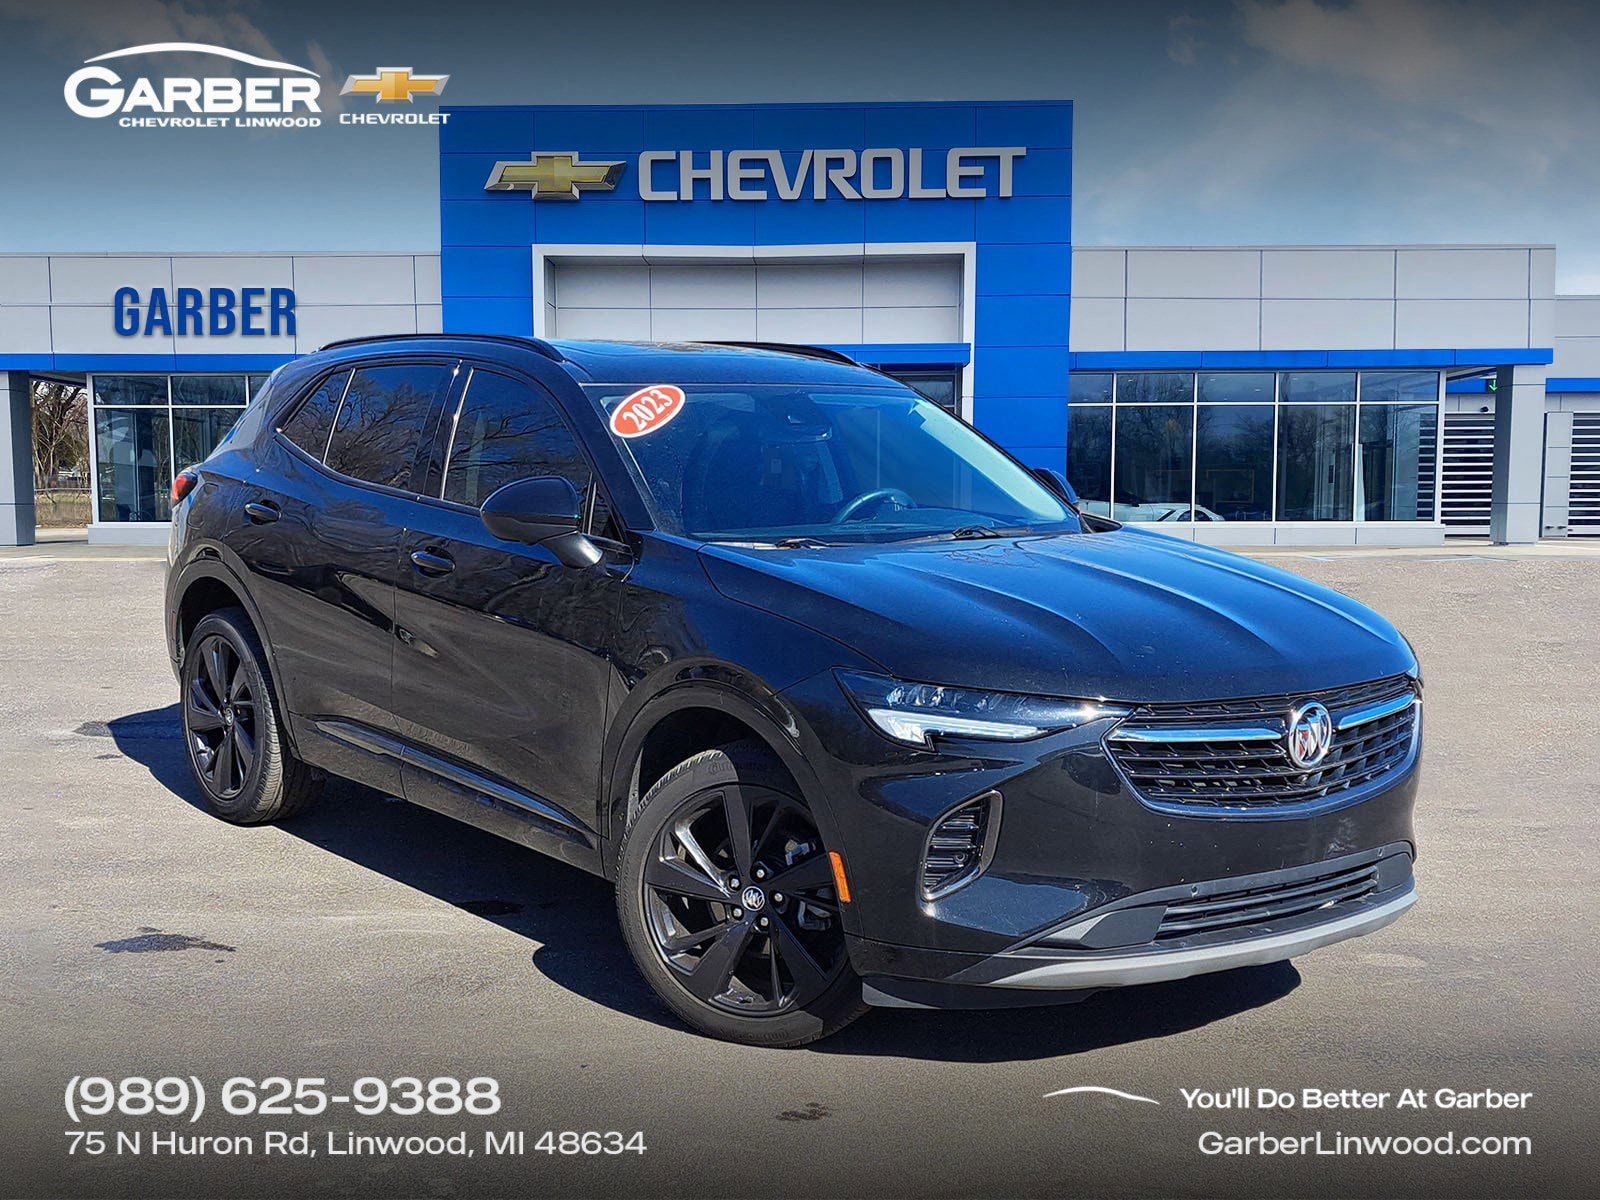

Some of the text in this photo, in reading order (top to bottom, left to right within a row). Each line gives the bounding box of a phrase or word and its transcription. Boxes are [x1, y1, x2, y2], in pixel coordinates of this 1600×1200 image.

[638, 146, 1027, 201] CHEVROLET
[114, 286, 297, 337] GARBER
[622, 389, 673, 432] 2023
